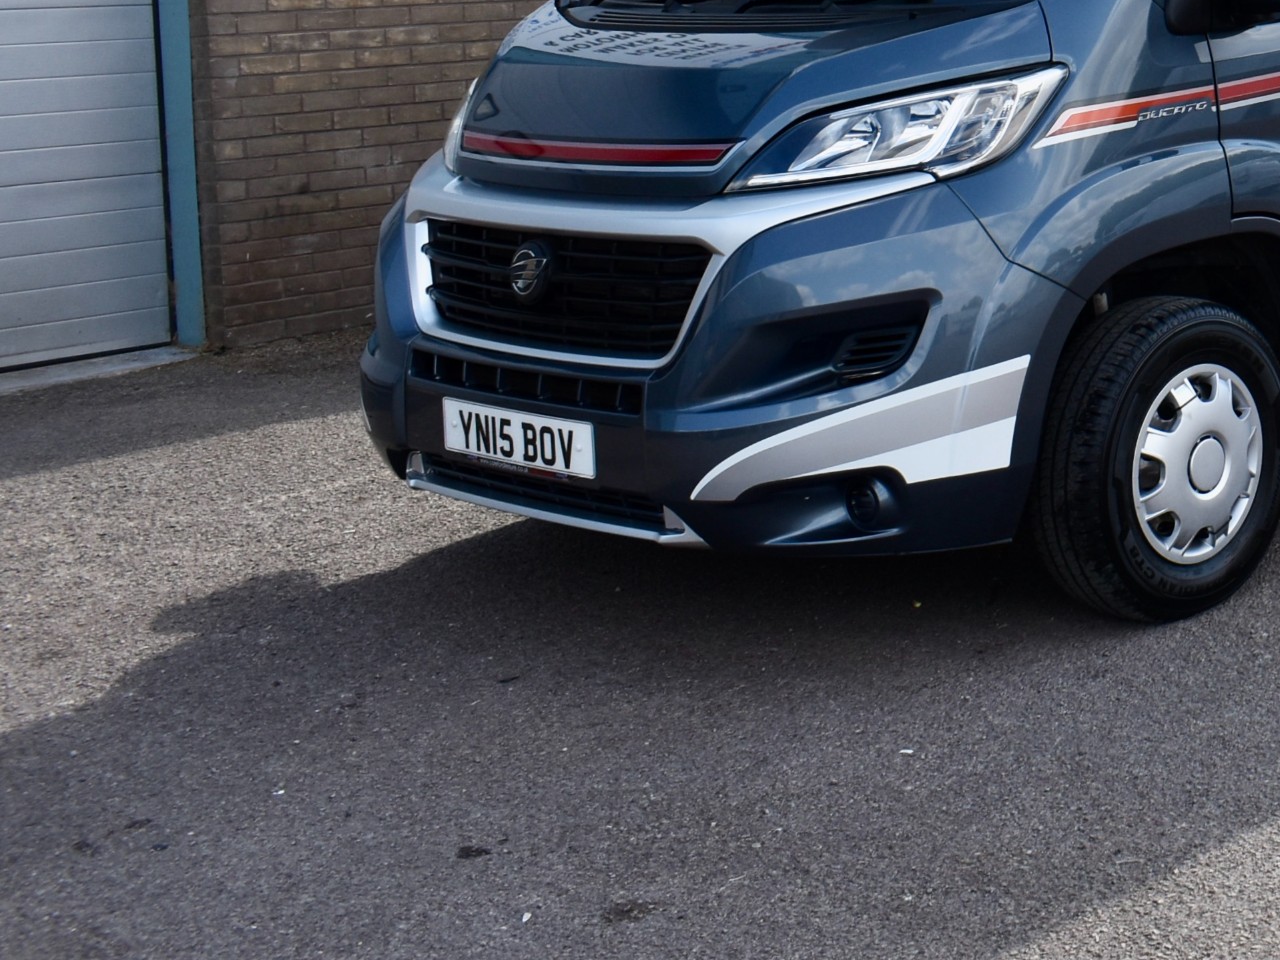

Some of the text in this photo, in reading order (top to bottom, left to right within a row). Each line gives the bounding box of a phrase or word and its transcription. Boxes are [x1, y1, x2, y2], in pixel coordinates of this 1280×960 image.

[1138, 101, 1207, 121] DUCATO
[458, 409, 573, 469] YN15 BOV
